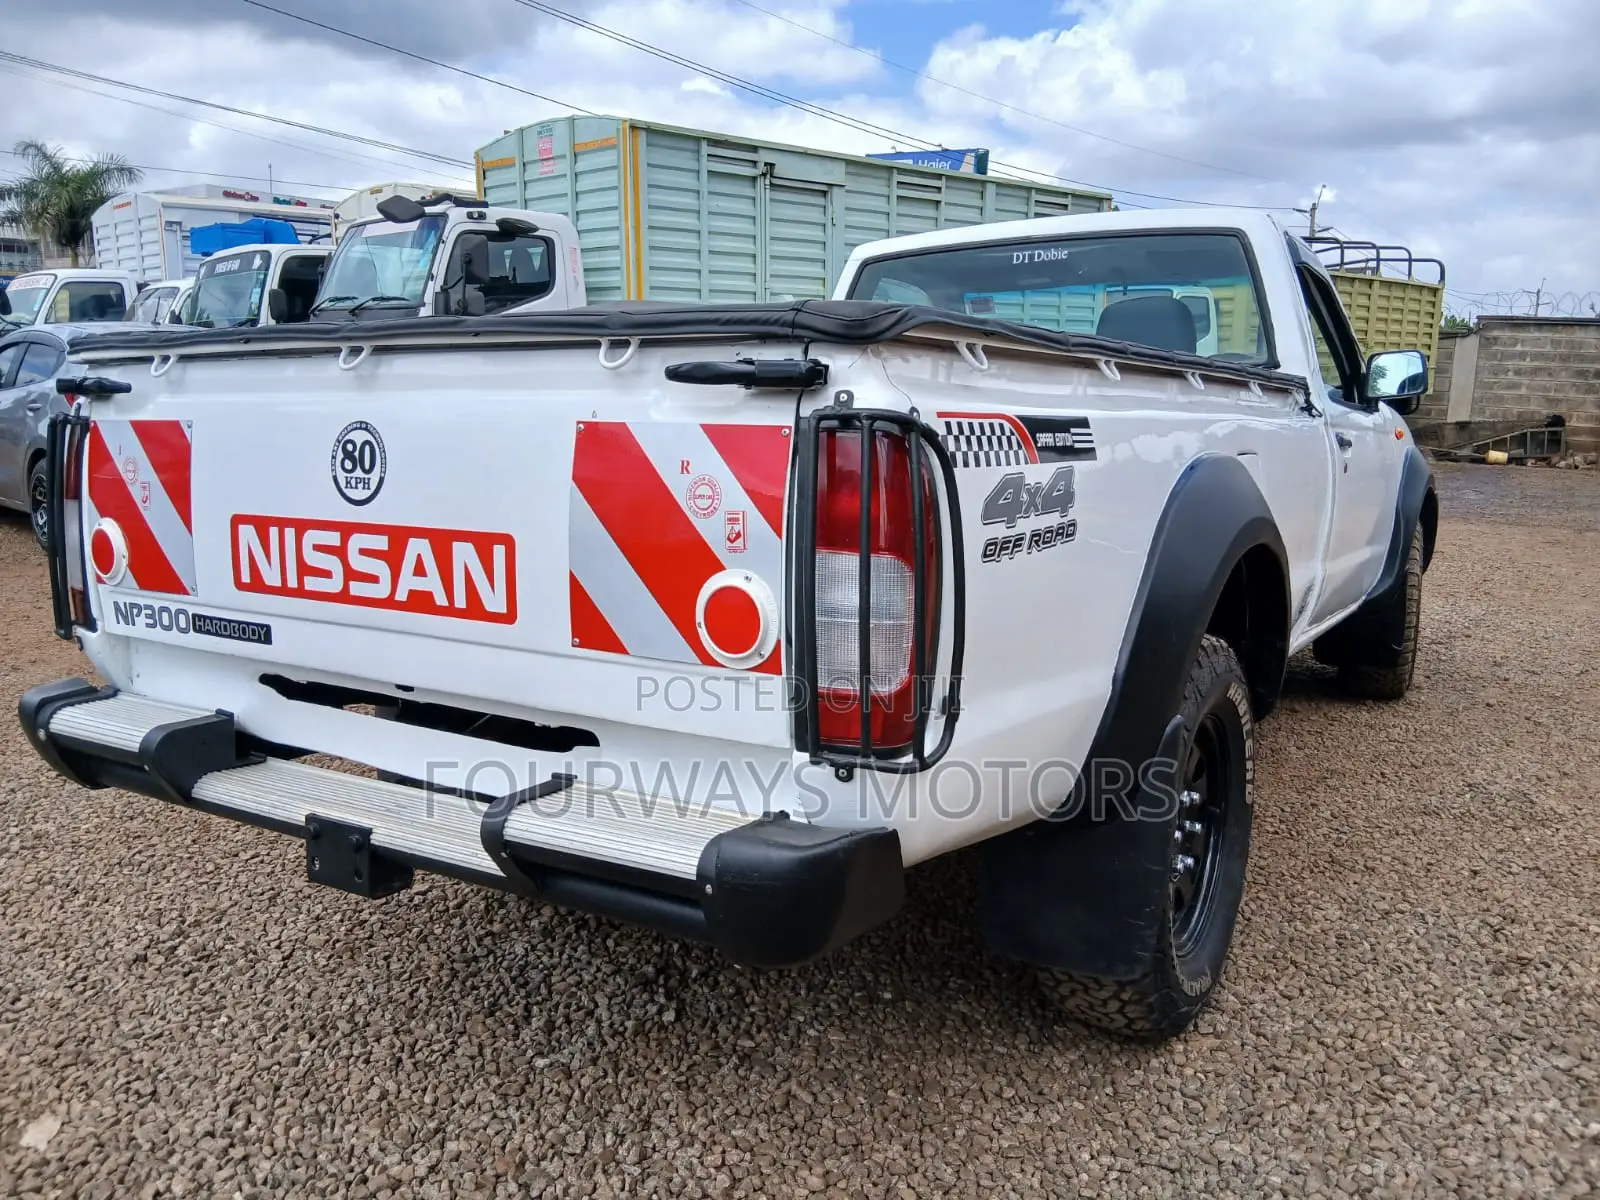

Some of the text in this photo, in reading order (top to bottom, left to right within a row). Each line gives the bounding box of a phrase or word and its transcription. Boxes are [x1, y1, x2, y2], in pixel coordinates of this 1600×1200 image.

[1012, 247, 1069, 264] DT Dobie
[340, 438, 377, 475] 80
[680, 459, 692, 475] R
[344, 475, 371, 490] KPH
[981, 465, 1075, 529] 4x4
[981, 519, 1077, 563] OFF ROAD
[238, 524, 508, 614] NISSAN
[113, 600, 267, 641] NP300 HARDBODY
